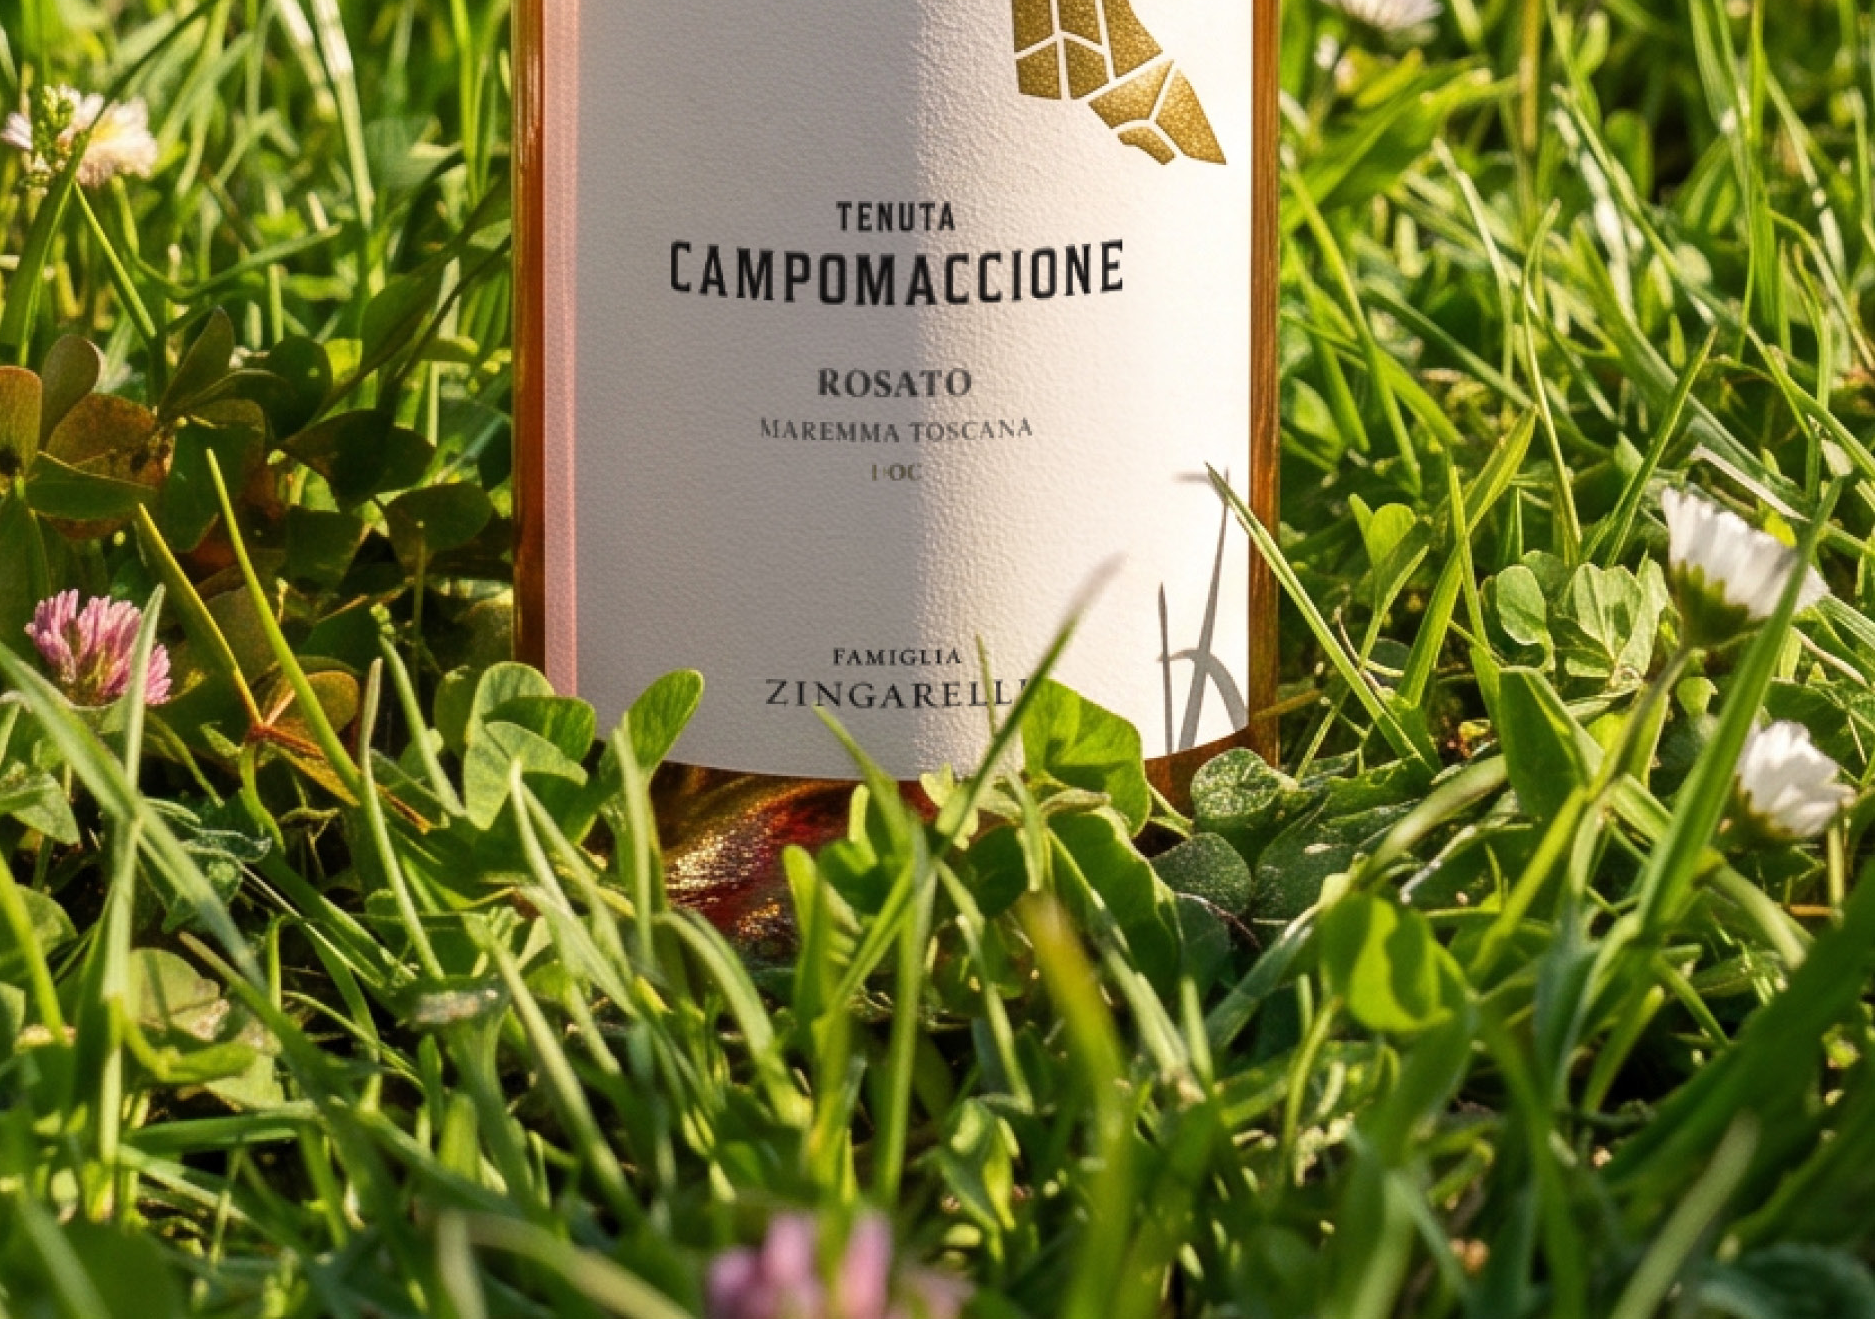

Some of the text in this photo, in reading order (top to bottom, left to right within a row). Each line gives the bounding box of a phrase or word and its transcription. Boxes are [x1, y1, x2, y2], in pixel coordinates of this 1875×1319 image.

[836, 201, 956, 231] TENUTA
[669, 239, 1124, 306] CAMPOMACCIONE
[816, 366, 973, 398] ROSATO
[760, 416, 1033, 443] MAREMMA TOSCANA
[832, 647, 963, 666] FAMIGLIA
